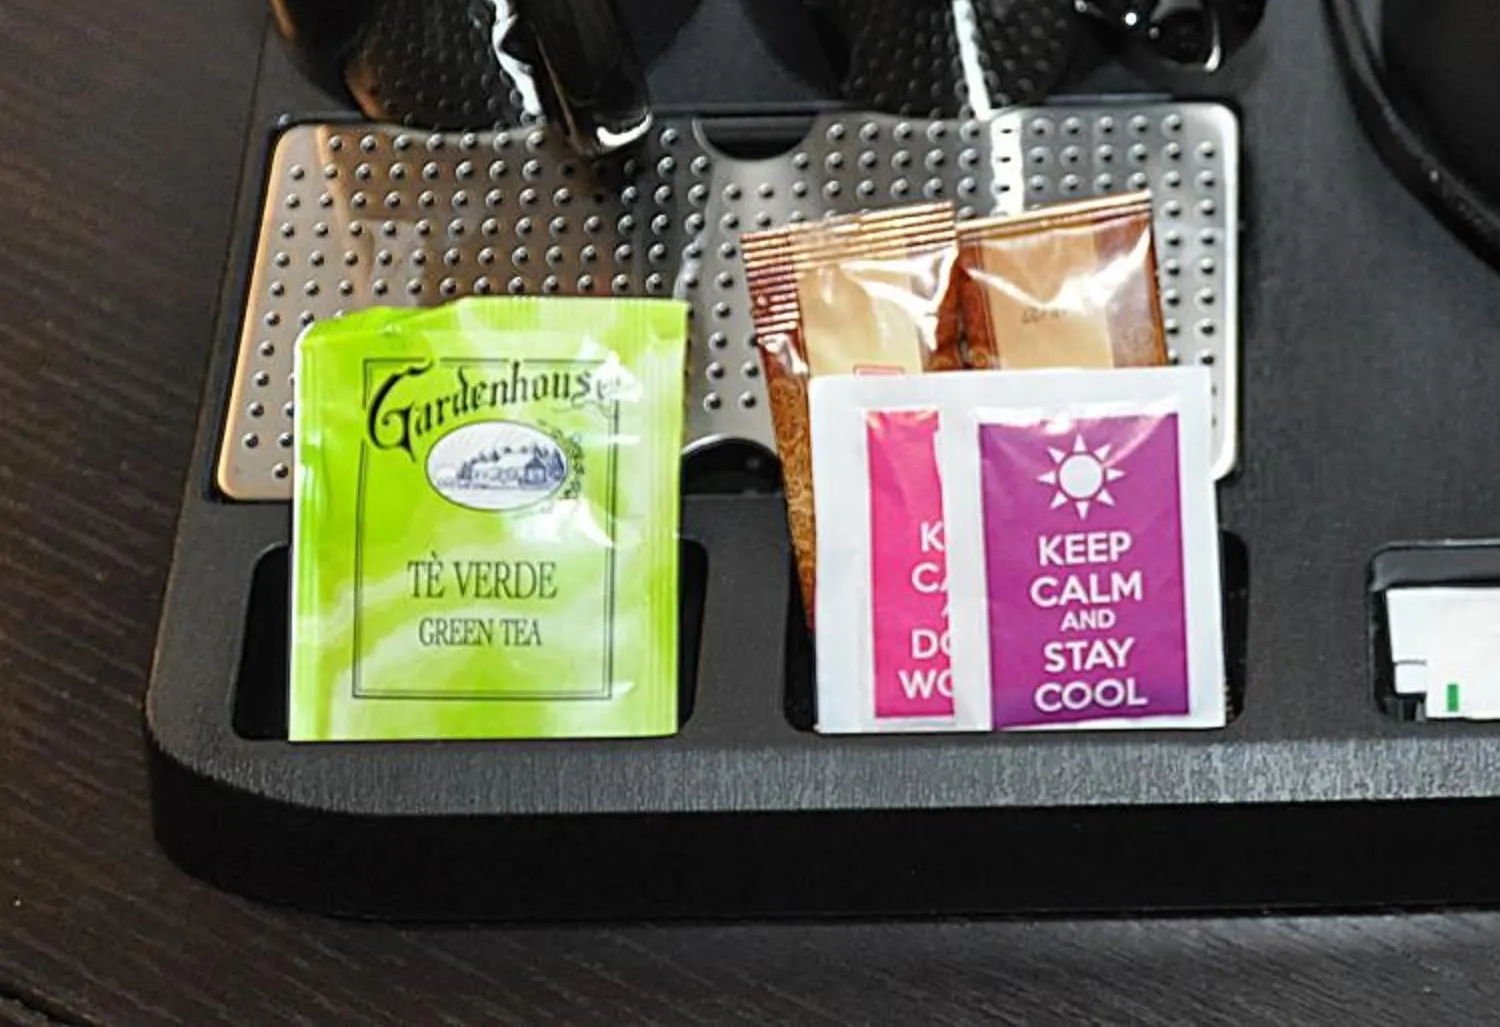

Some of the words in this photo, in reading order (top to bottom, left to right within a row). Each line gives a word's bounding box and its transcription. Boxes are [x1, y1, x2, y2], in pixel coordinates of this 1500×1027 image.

[1038, 531, 1132, 567] KEEP
[407, 550, 445, 598] TÈ
[453, 560, 558, 599] VERDE
[1030, 570, 1143, 607] CALM
[419, 617, 493, 647] GREEN
[500, 618, 542, 647] TEA
[1060, 608, 1117, 632] AND
[1044, 637, 1135, 673] STAY
[1034, 677, 1148, 712] COOL
